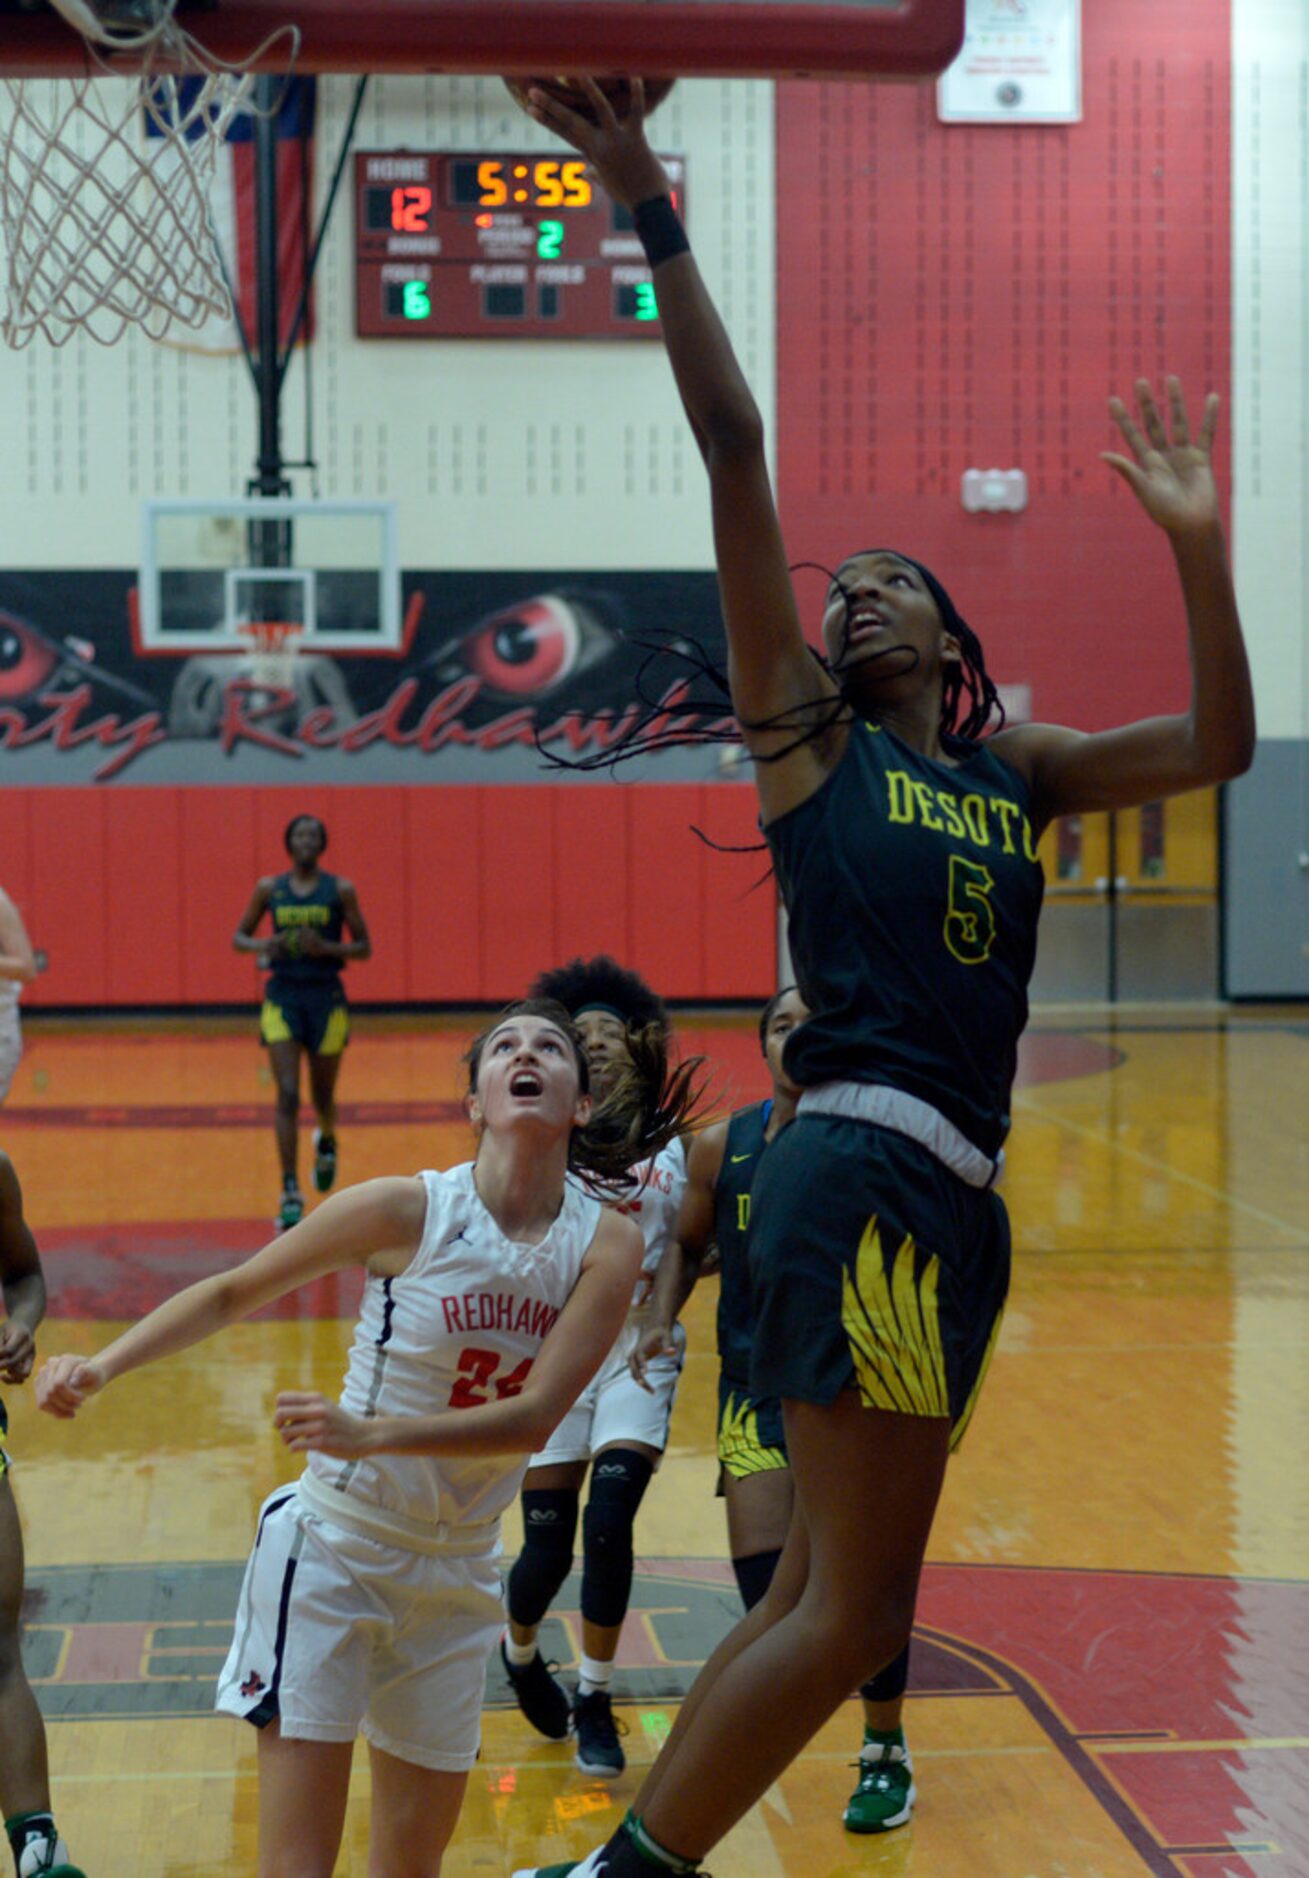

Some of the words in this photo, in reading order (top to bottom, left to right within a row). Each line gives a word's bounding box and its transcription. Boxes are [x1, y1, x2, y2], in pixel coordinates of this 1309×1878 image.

[366, 157, 429, 182] HOME
[477, 161, 592, 207] 5:55
[391, 186, 432, 232] 12
[537, 220, 564, 259] 2
[403, 280, 431, 319] 6
[634, 282, 659, 320] 3
[943, 854, 996, 965] 5
